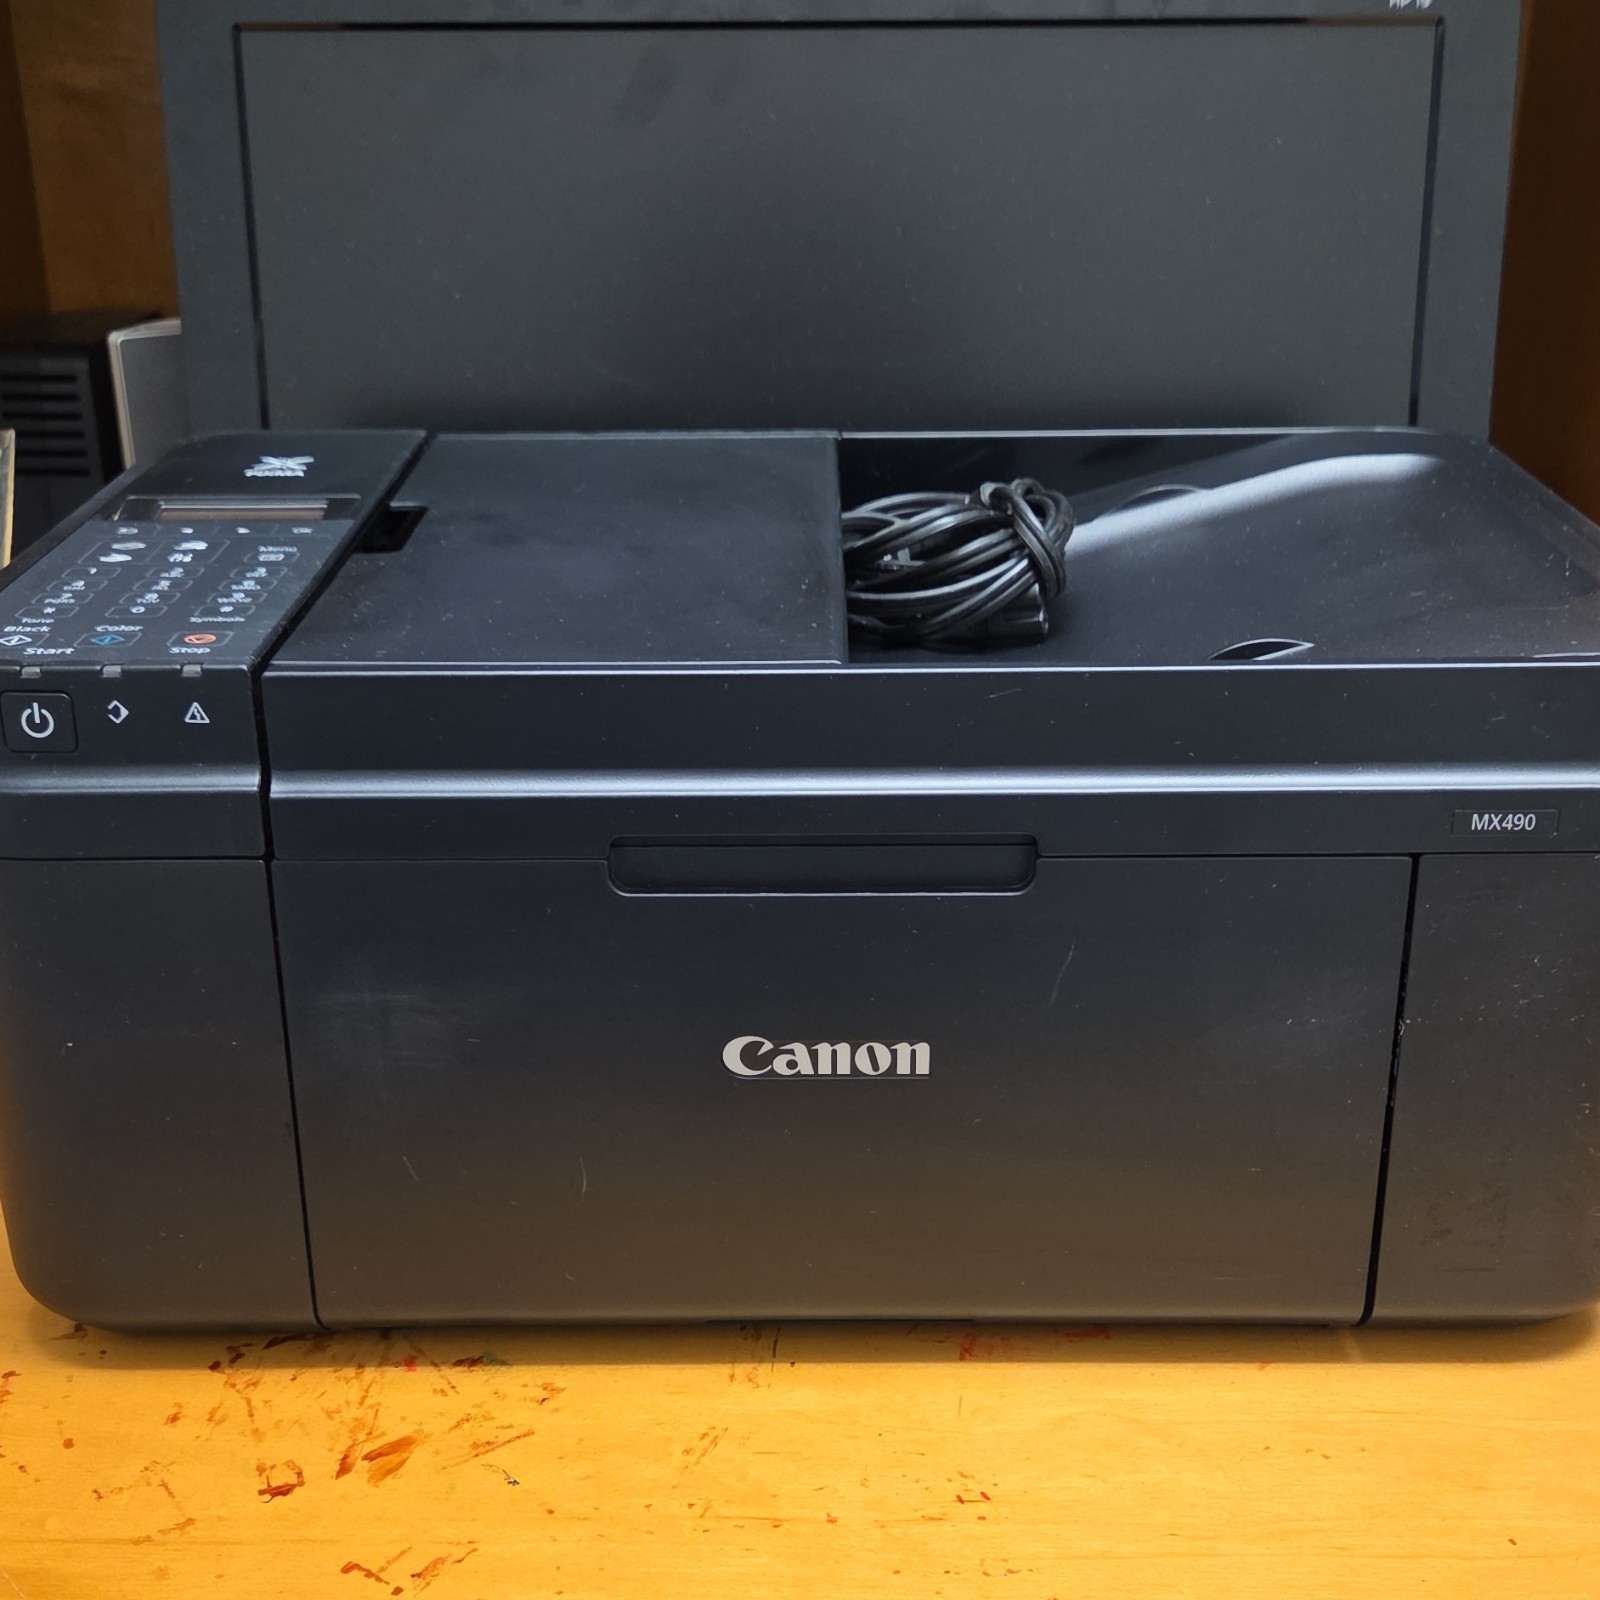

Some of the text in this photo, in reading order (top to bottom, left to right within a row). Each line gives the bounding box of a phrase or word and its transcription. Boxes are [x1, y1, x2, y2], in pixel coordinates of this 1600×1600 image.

[95, 624, 143, 632] Color
[23, 647, 75, 655] Start
[169, 646, 211, 655] Stop
[1471, 813, 1536, 831] MX490
[722, 1035, 931, 1076] Canon
